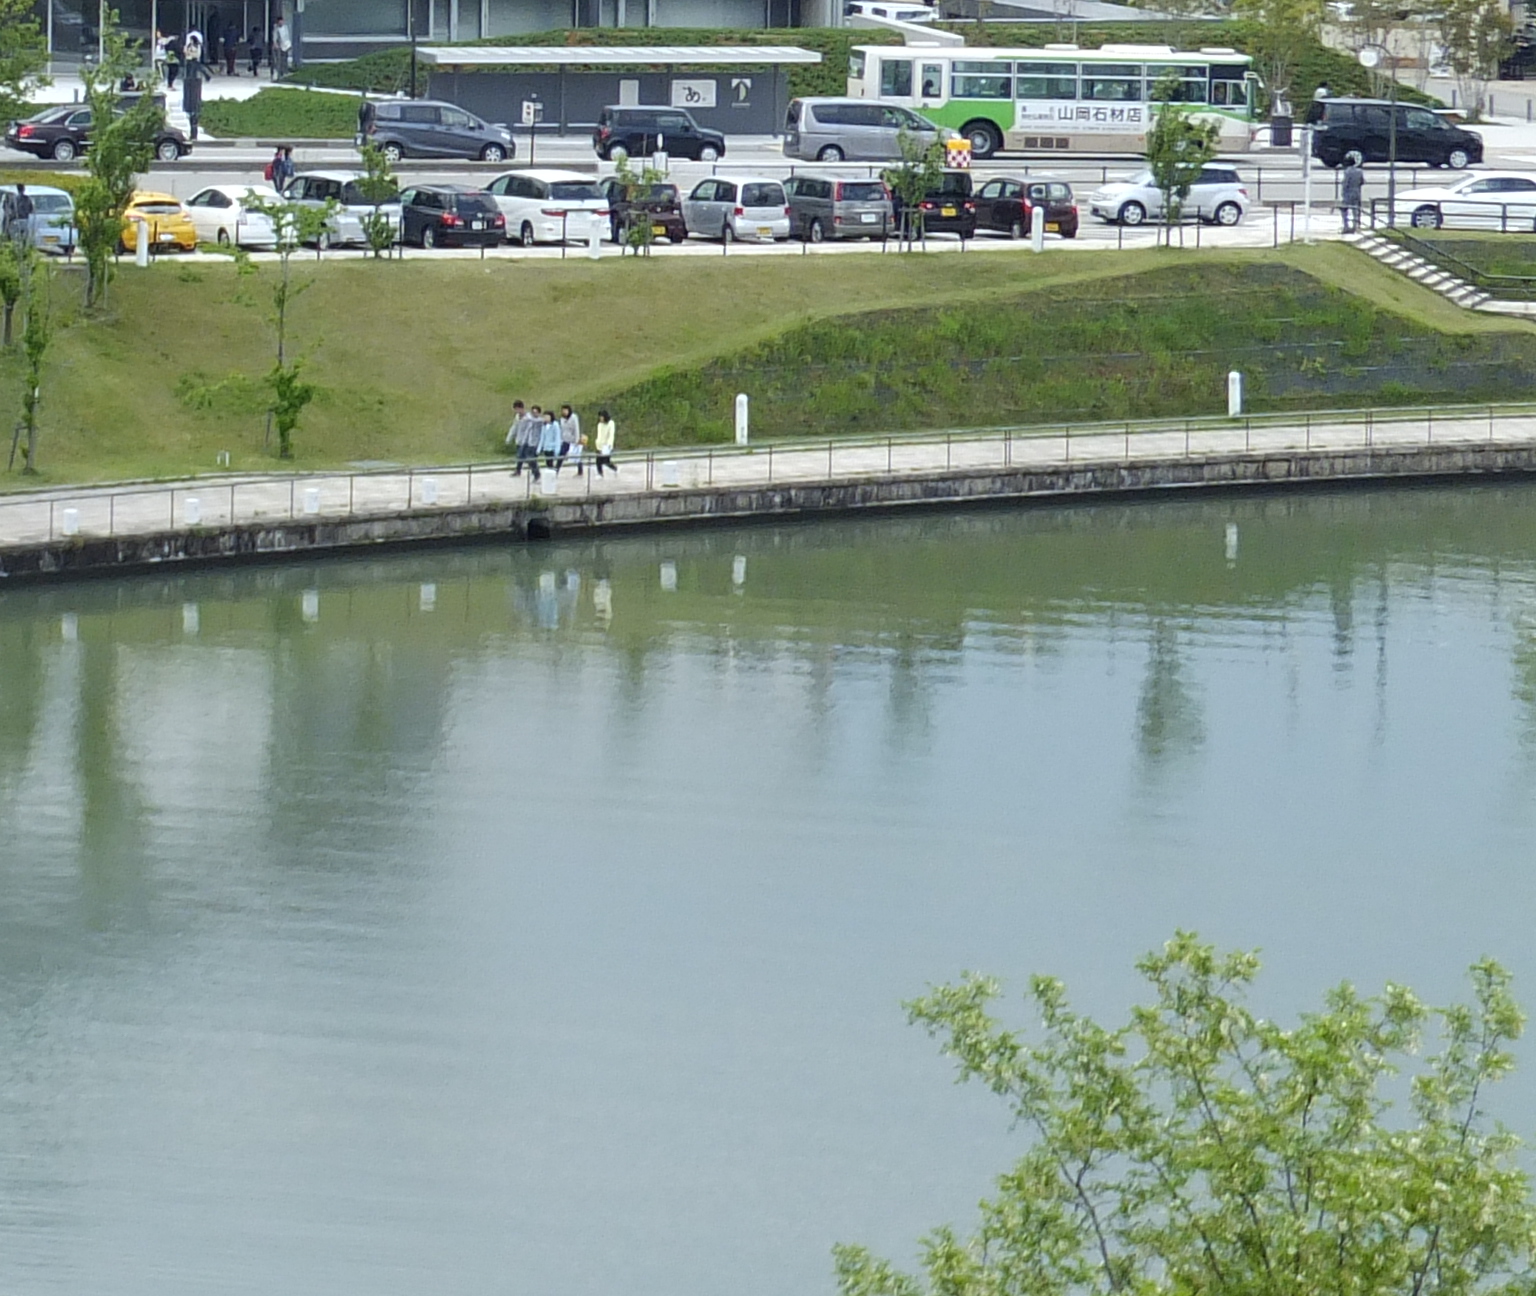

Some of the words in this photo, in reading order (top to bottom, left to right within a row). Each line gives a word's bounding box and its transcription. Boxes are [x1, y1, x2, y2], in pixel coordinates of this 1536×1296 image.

[1057, 106, 1142, 123] 山岡石材店
